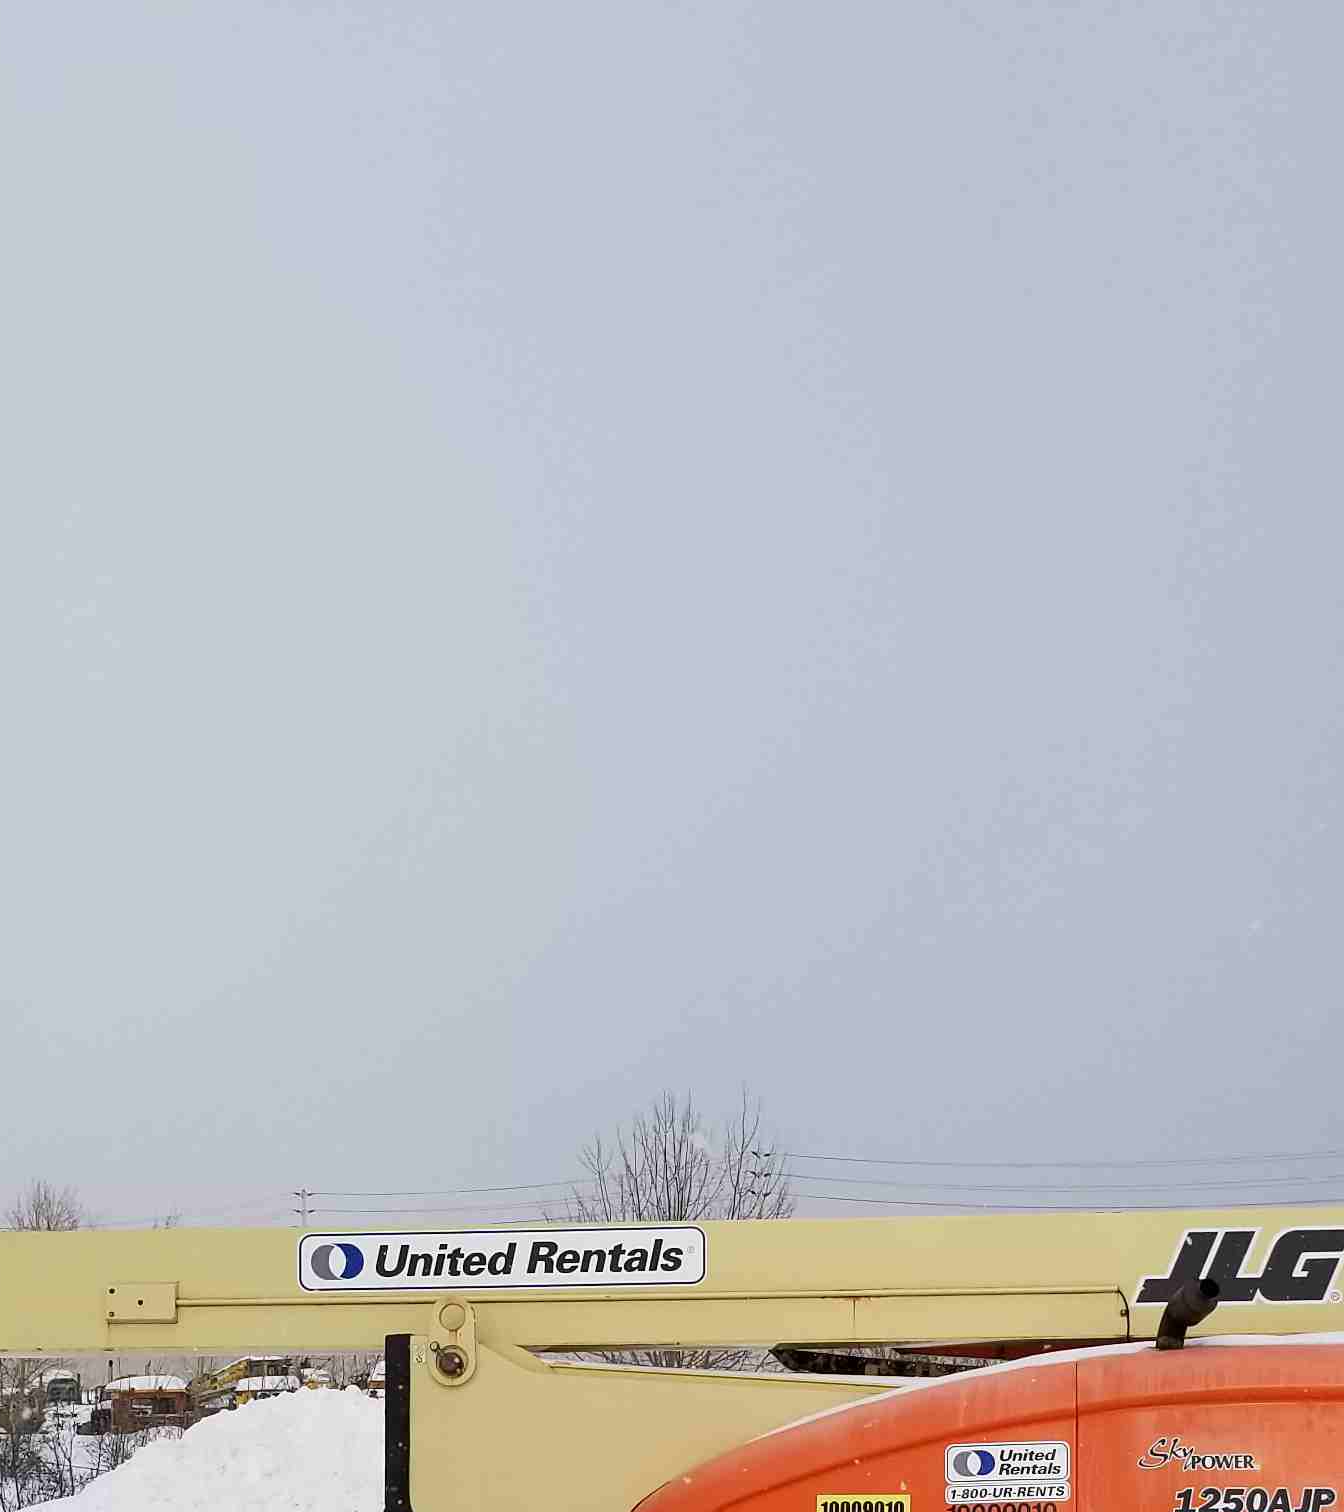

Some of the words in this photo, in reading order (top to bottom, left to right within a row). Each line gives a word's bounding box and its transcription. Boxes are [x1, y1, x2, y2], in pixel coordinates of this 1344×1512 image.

[375, 1243, 516, 1278] United
[526, 1238, 684, 1275] Rentals
[1000, 1449, 1056, 1462] United
[998, 1463, 1061, 1476] Rentals
[951, 1485, 1065, 1500] 1-800-UR-RENTS
